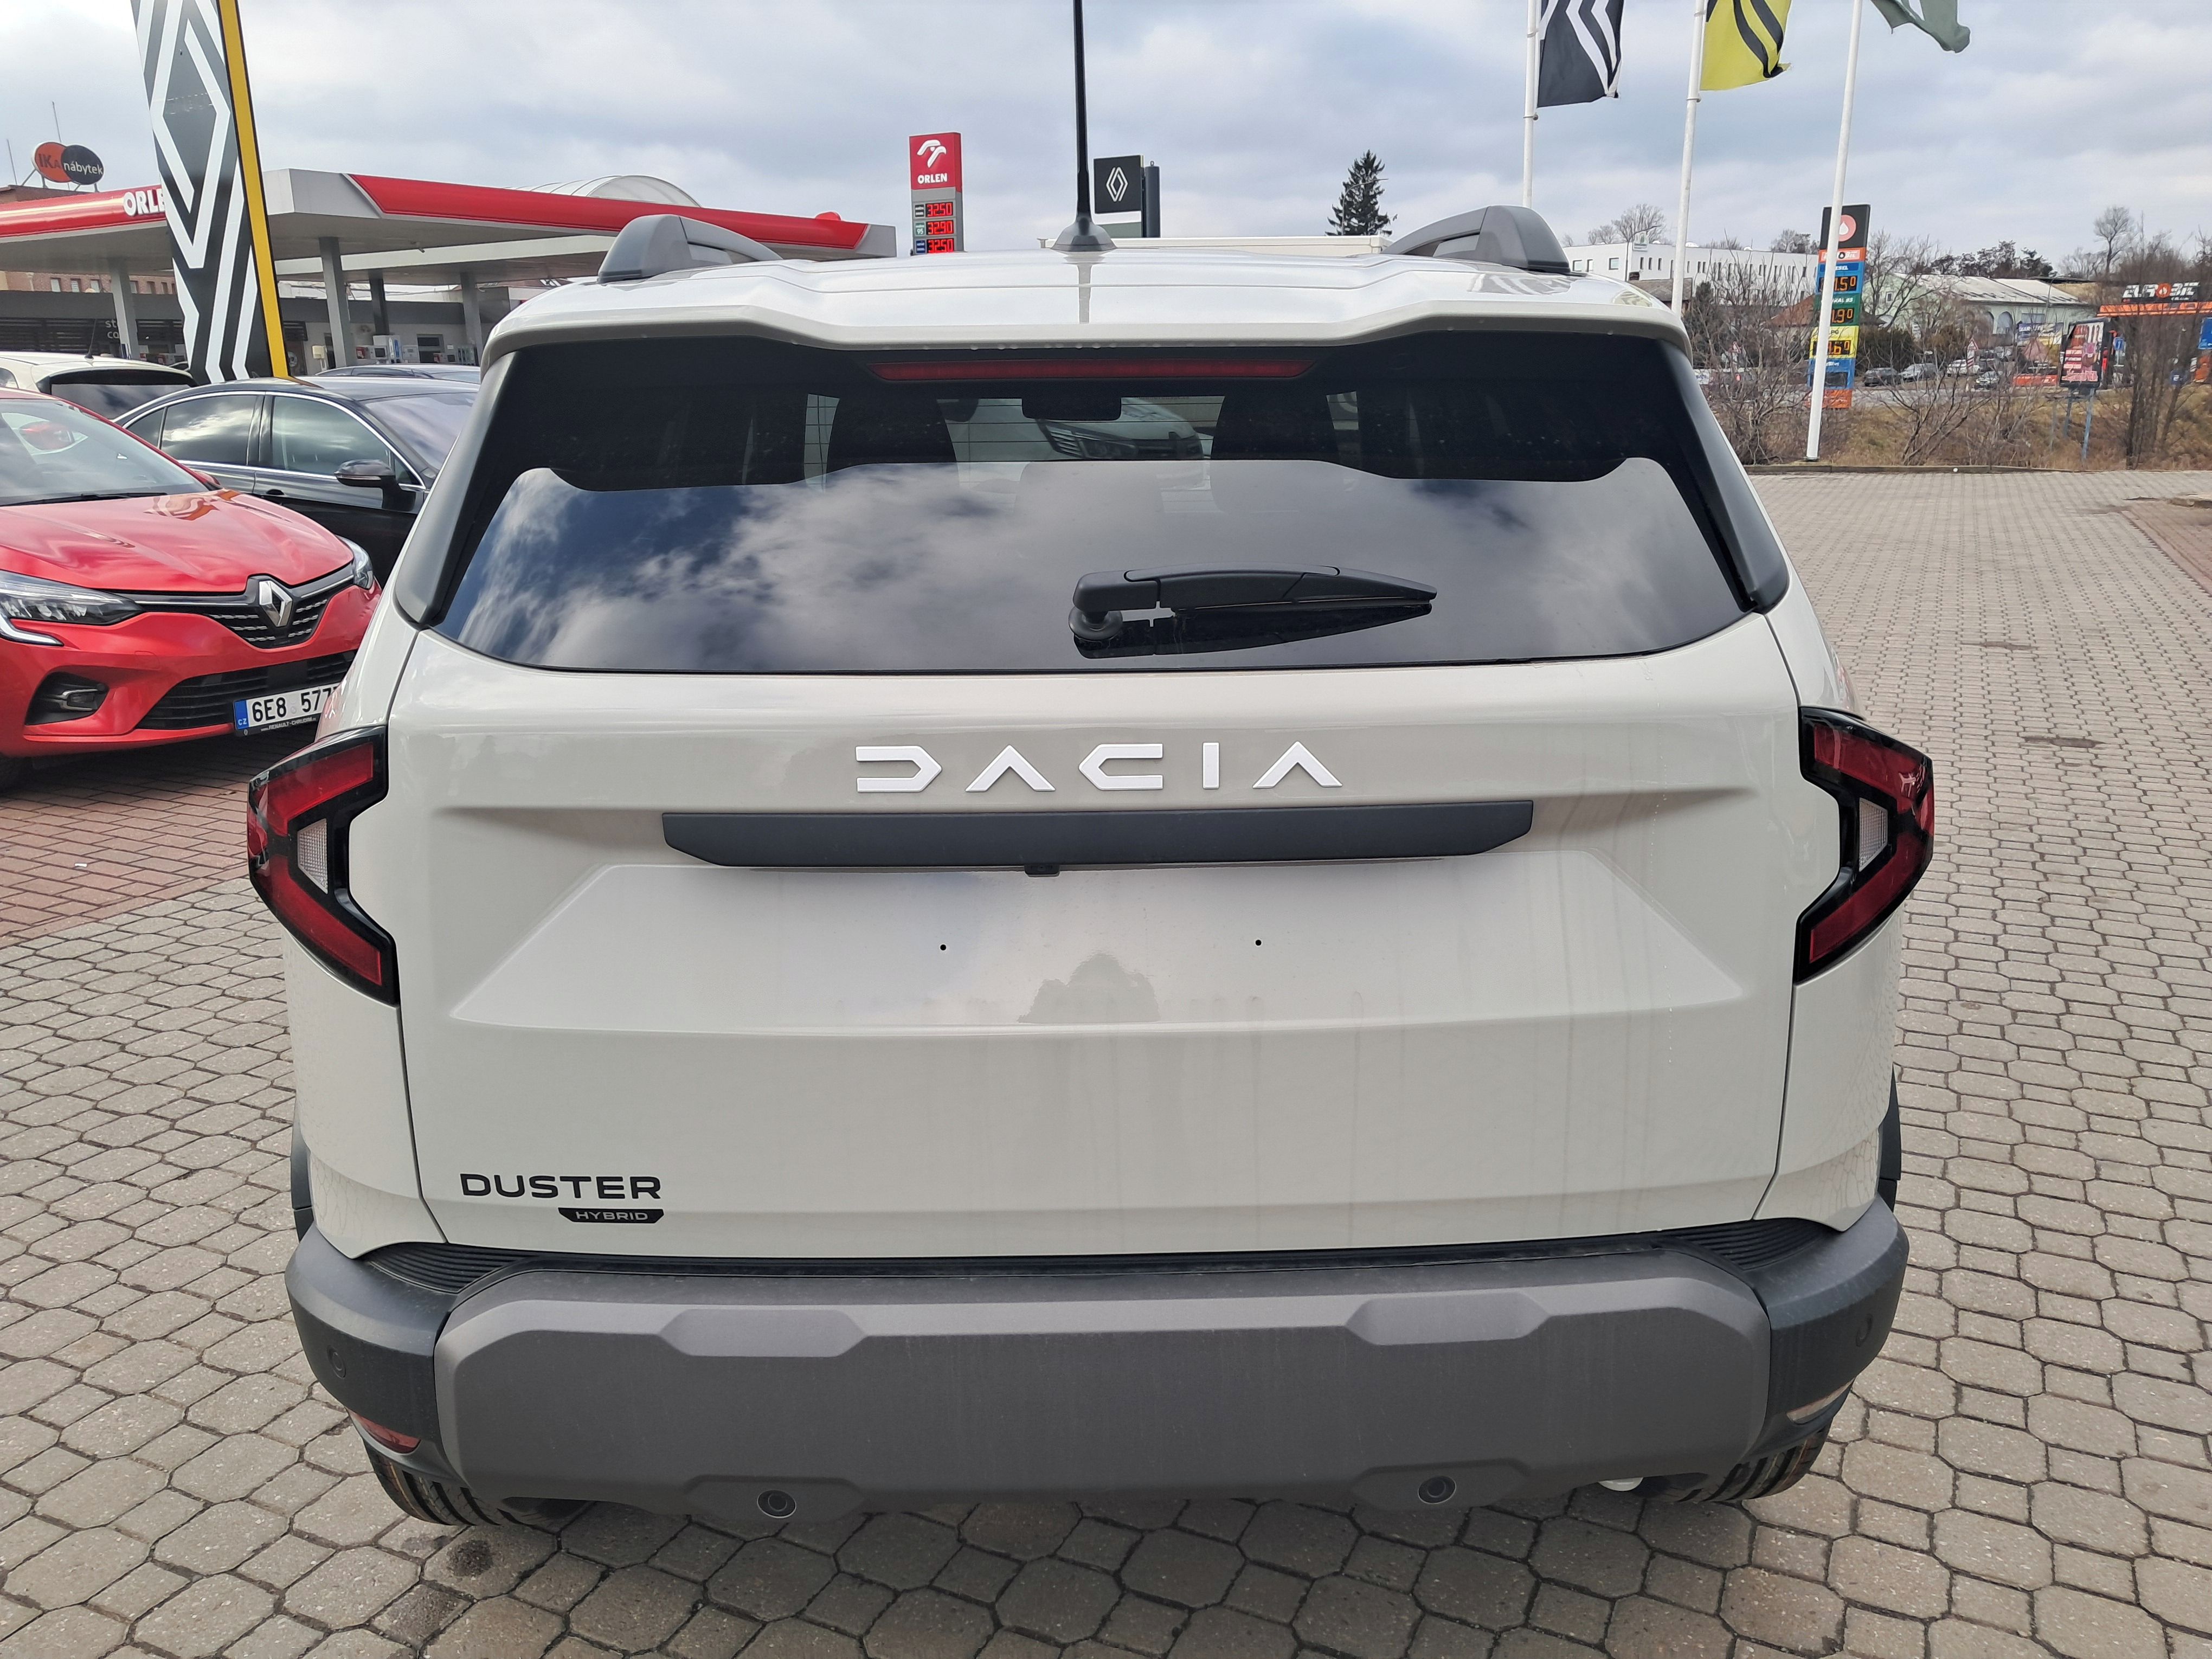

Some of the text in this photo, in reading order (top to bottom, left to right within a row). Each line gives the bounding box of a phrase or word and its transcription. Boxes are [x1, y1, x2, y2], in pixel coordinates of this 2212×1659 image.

[63, 161, 103, 175] nábytek
[917, 173, 948, 184] ORLEN
[123, 188, 165, 216] ORLE
[252, 686, 338, 723] 6E8 577
[855, 741, 1343, 793] DACIA
[460, 1173, 661, 1199] DUSTER
[575, 1211, 648, 1220] HYBRID
